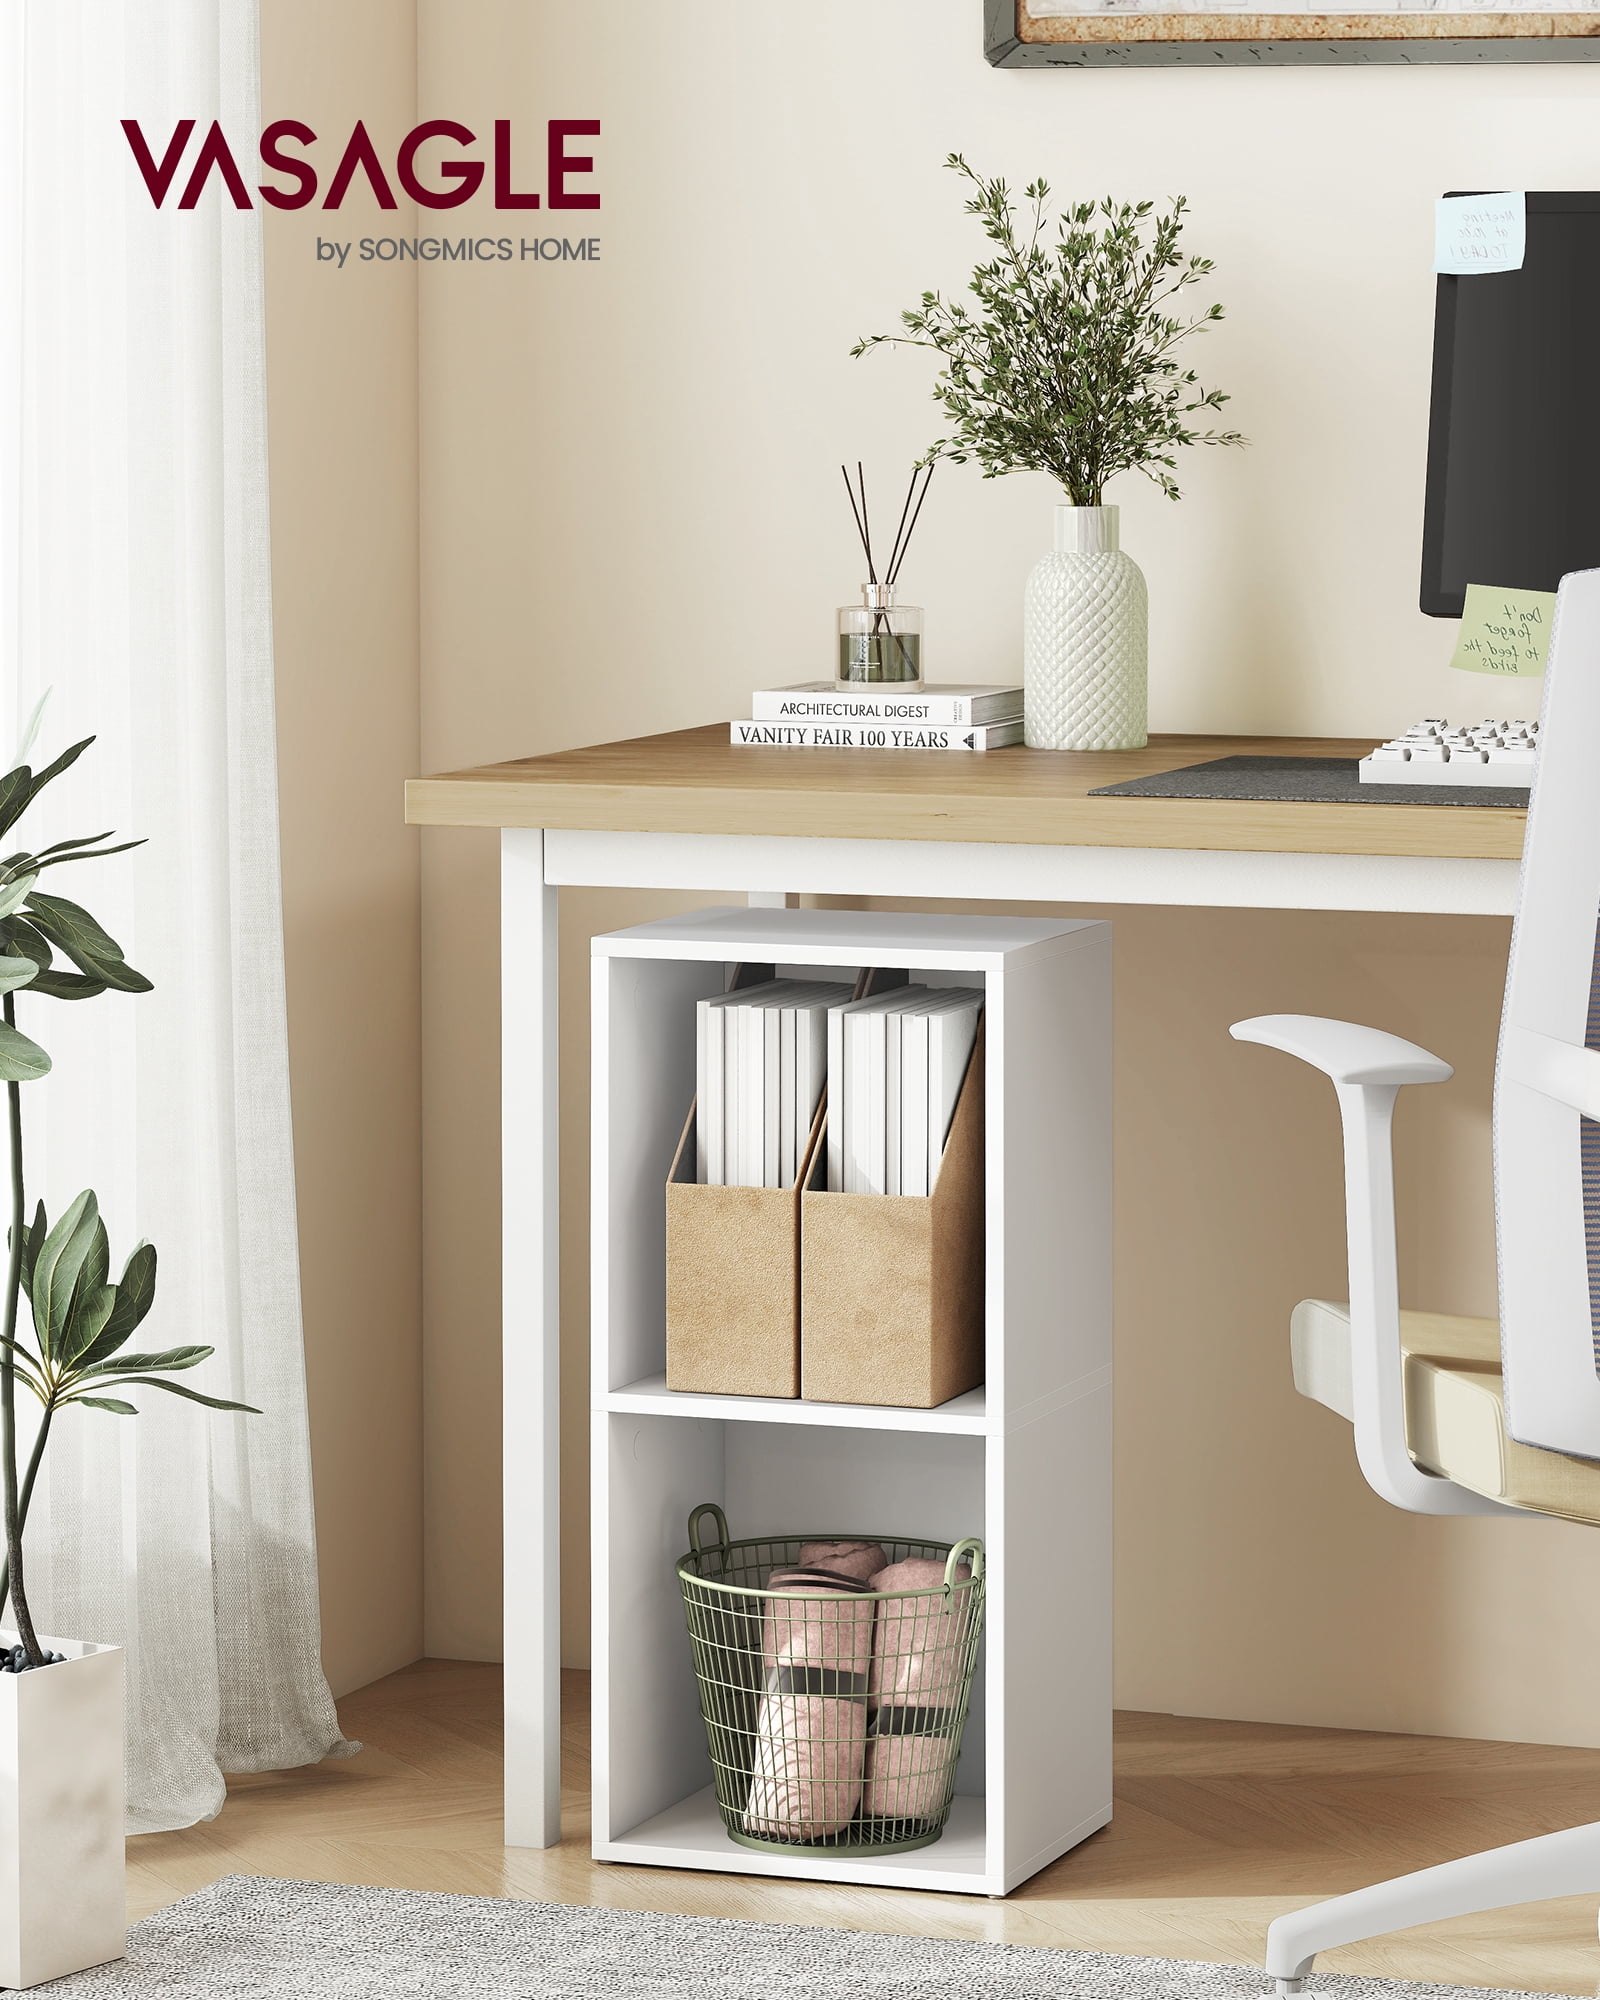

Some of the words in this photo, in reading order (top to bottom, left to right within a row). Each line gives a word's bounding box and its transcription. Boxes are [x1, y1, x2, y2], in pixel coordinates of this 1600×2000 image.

[780, 702, 881, 717] ARCHITECTURAL
[884, 704, 930, 718] DIGEST
[738, 726, 808, 744] VANITY
[813, 728, 854, 746] FAIR
[859, 730, 886, 746] 100
[891, 731, 949, 748] YEARS
